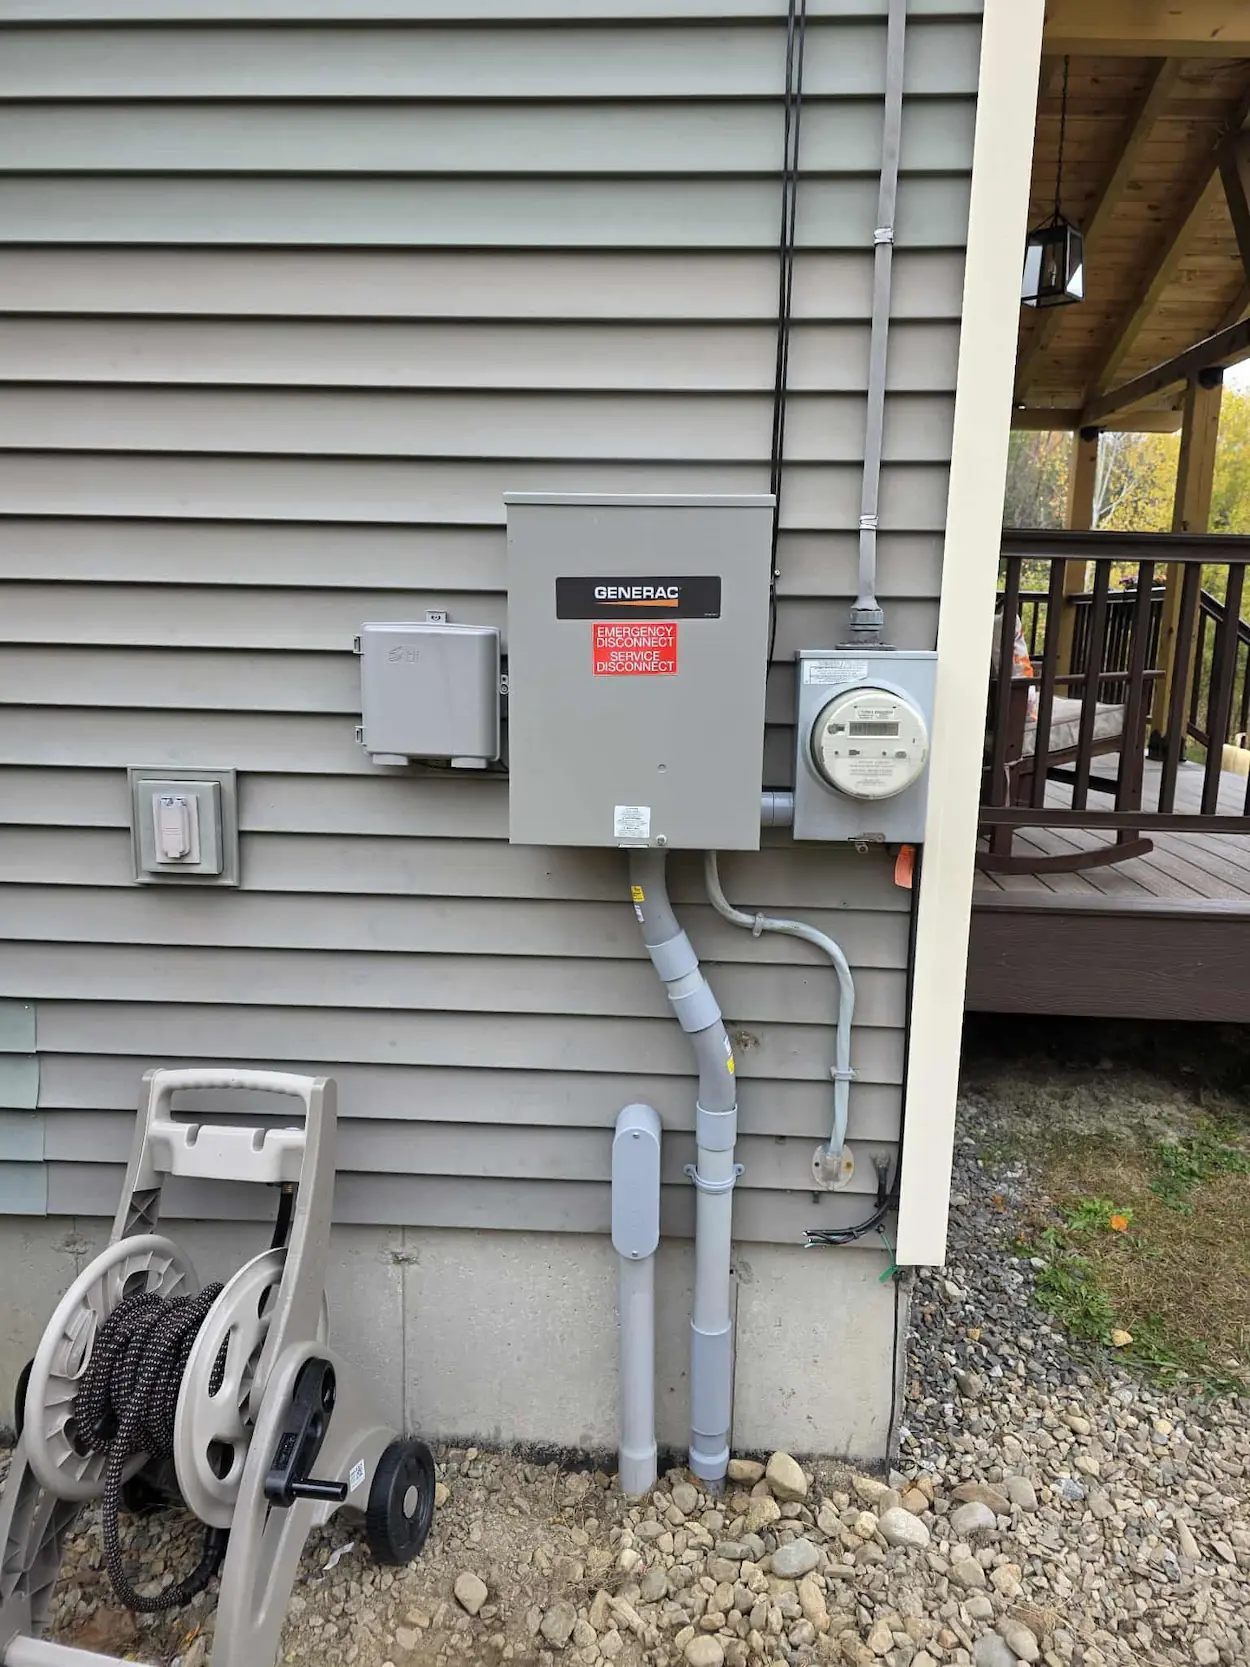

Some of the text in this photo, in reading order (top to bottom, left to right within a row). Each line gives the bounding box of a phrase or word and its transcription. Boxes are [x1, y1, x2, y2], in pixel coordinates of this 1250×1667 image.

[594, 586, 679, 599] GENERAC
[597, 626, 673, 637] EMERGENCY
[596, 637, 674, 648] DISCONNECT
[610, 651, 660, 662] SERVICE
[596, 661, 674, 672] DISCONNECT
